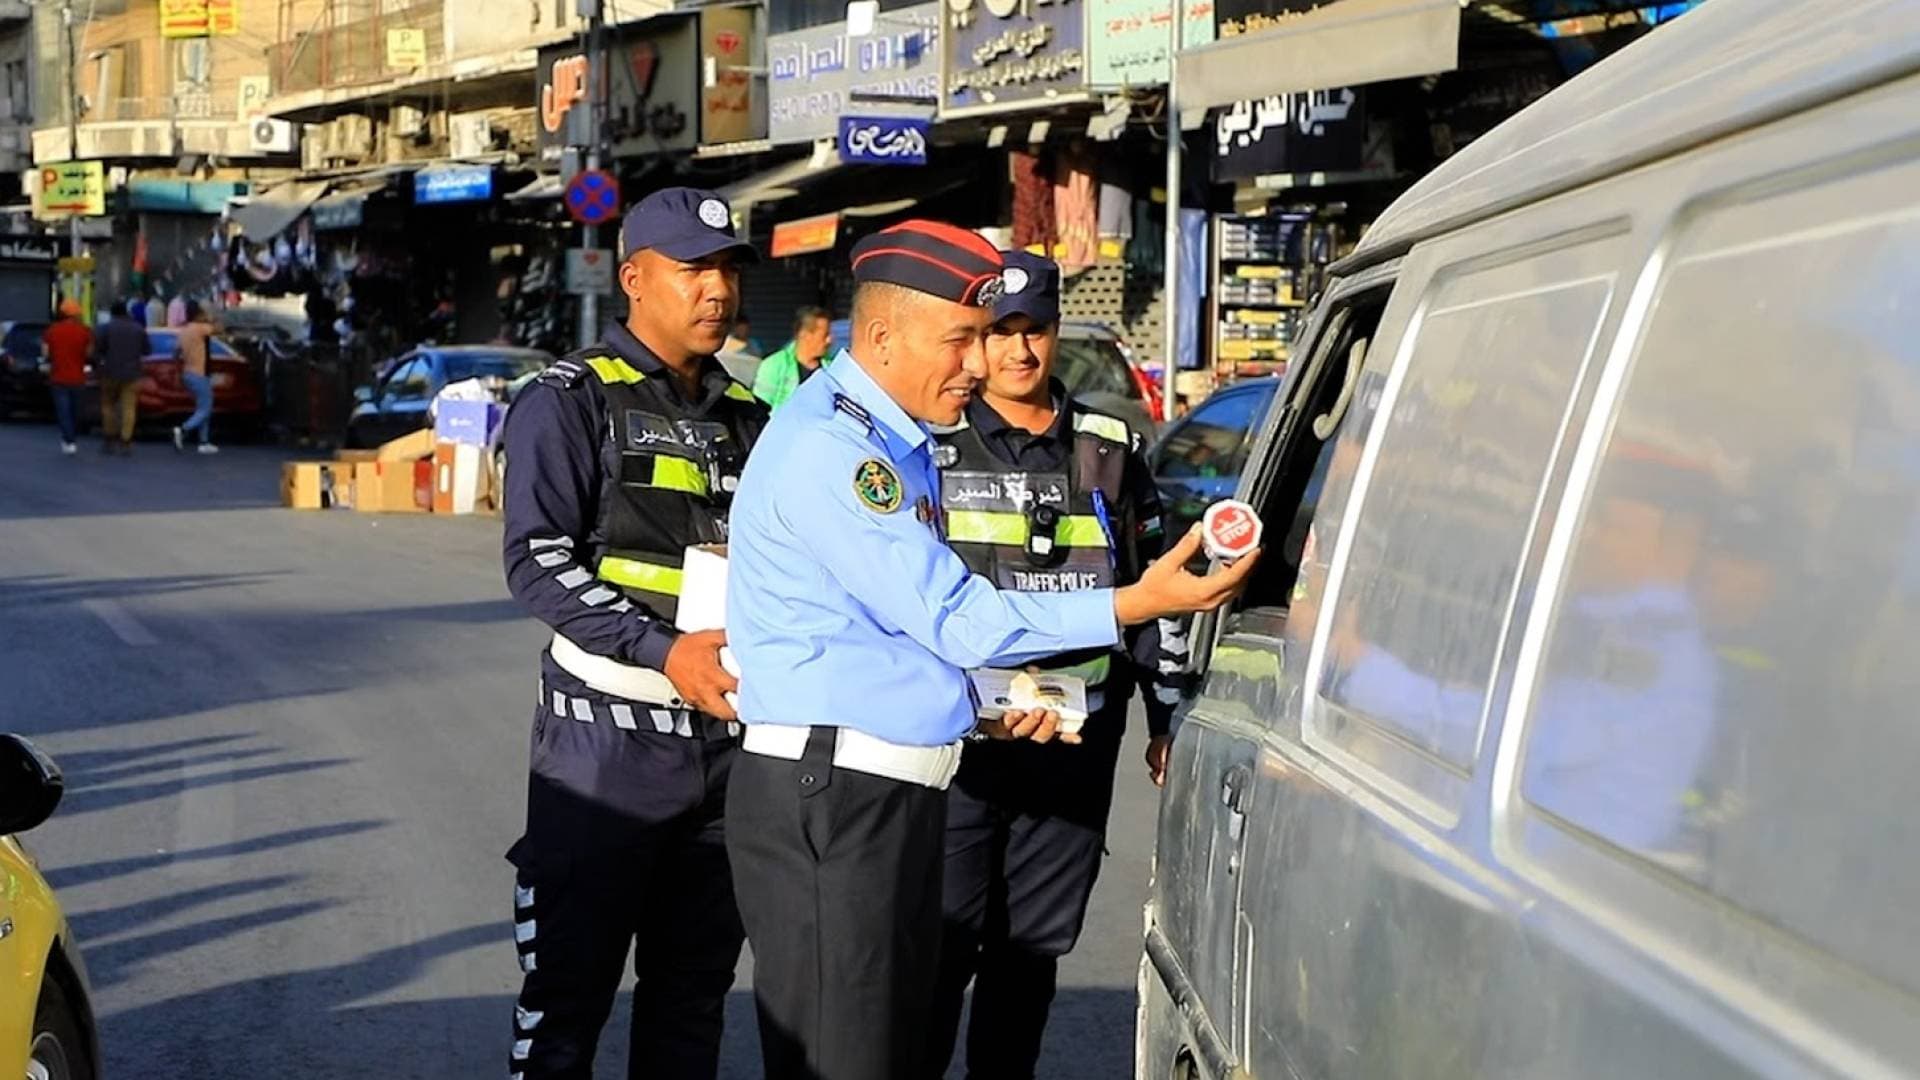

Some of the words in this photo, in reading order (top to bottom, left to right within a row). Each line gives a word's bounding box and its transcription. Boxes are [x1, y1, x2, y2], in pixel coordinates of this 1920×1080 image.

[42, 167, 58, 193] P
[948, 482, 1000, 502] السير
[1216, 520, 1252, 546] STOP
[1013, 571, 1059, 592] TRAFFIC
[1059, 571, 1098, 592] POLICE
